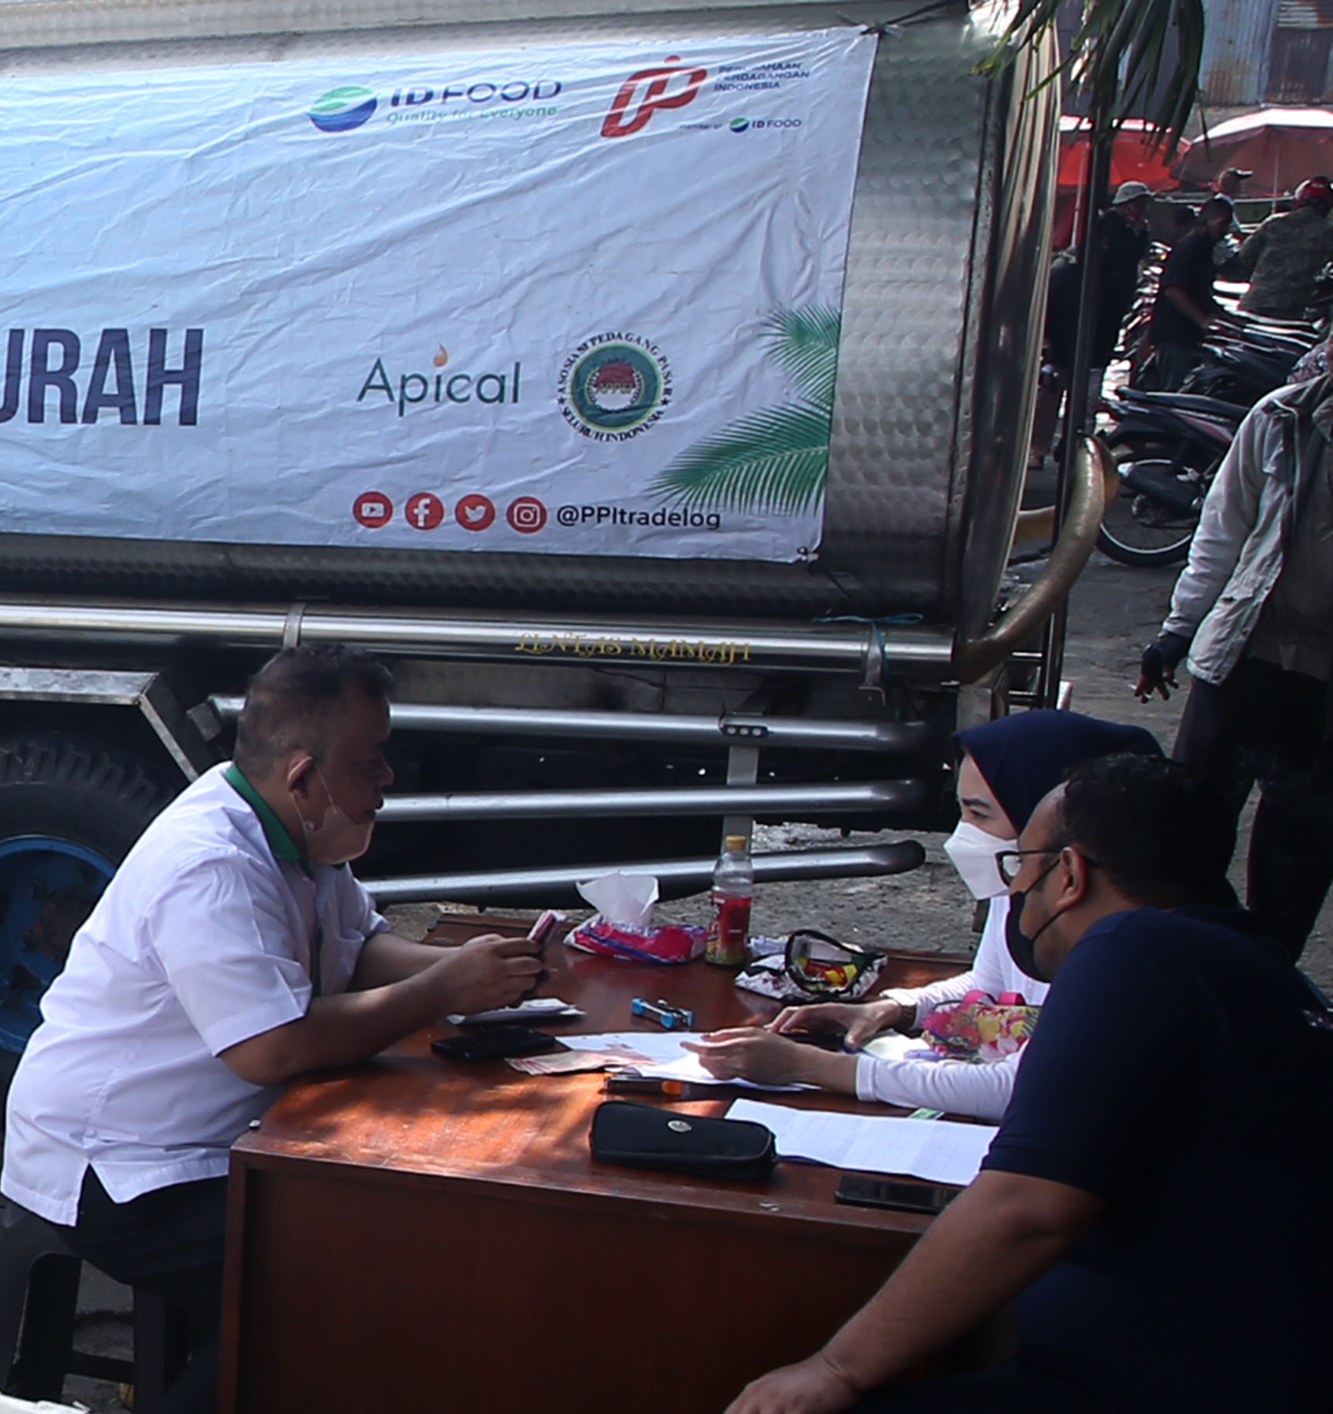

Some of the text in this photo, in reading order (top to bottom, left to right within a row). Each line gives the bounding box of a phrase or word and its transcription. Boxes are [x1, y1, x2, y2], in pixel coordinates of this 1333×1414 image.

[390, 80, 563, 107] ID FOOD
[713, 81, 781, 92] INDONESIA
[767, 119, 803, 129] FOOD
[589, 331, 661, 356] PEDAGANG
[356, 350, 522, 418] Apical
[556, 504, 722, 530] @PPItradelog
[514, 631, 623, 657] LINTAS
